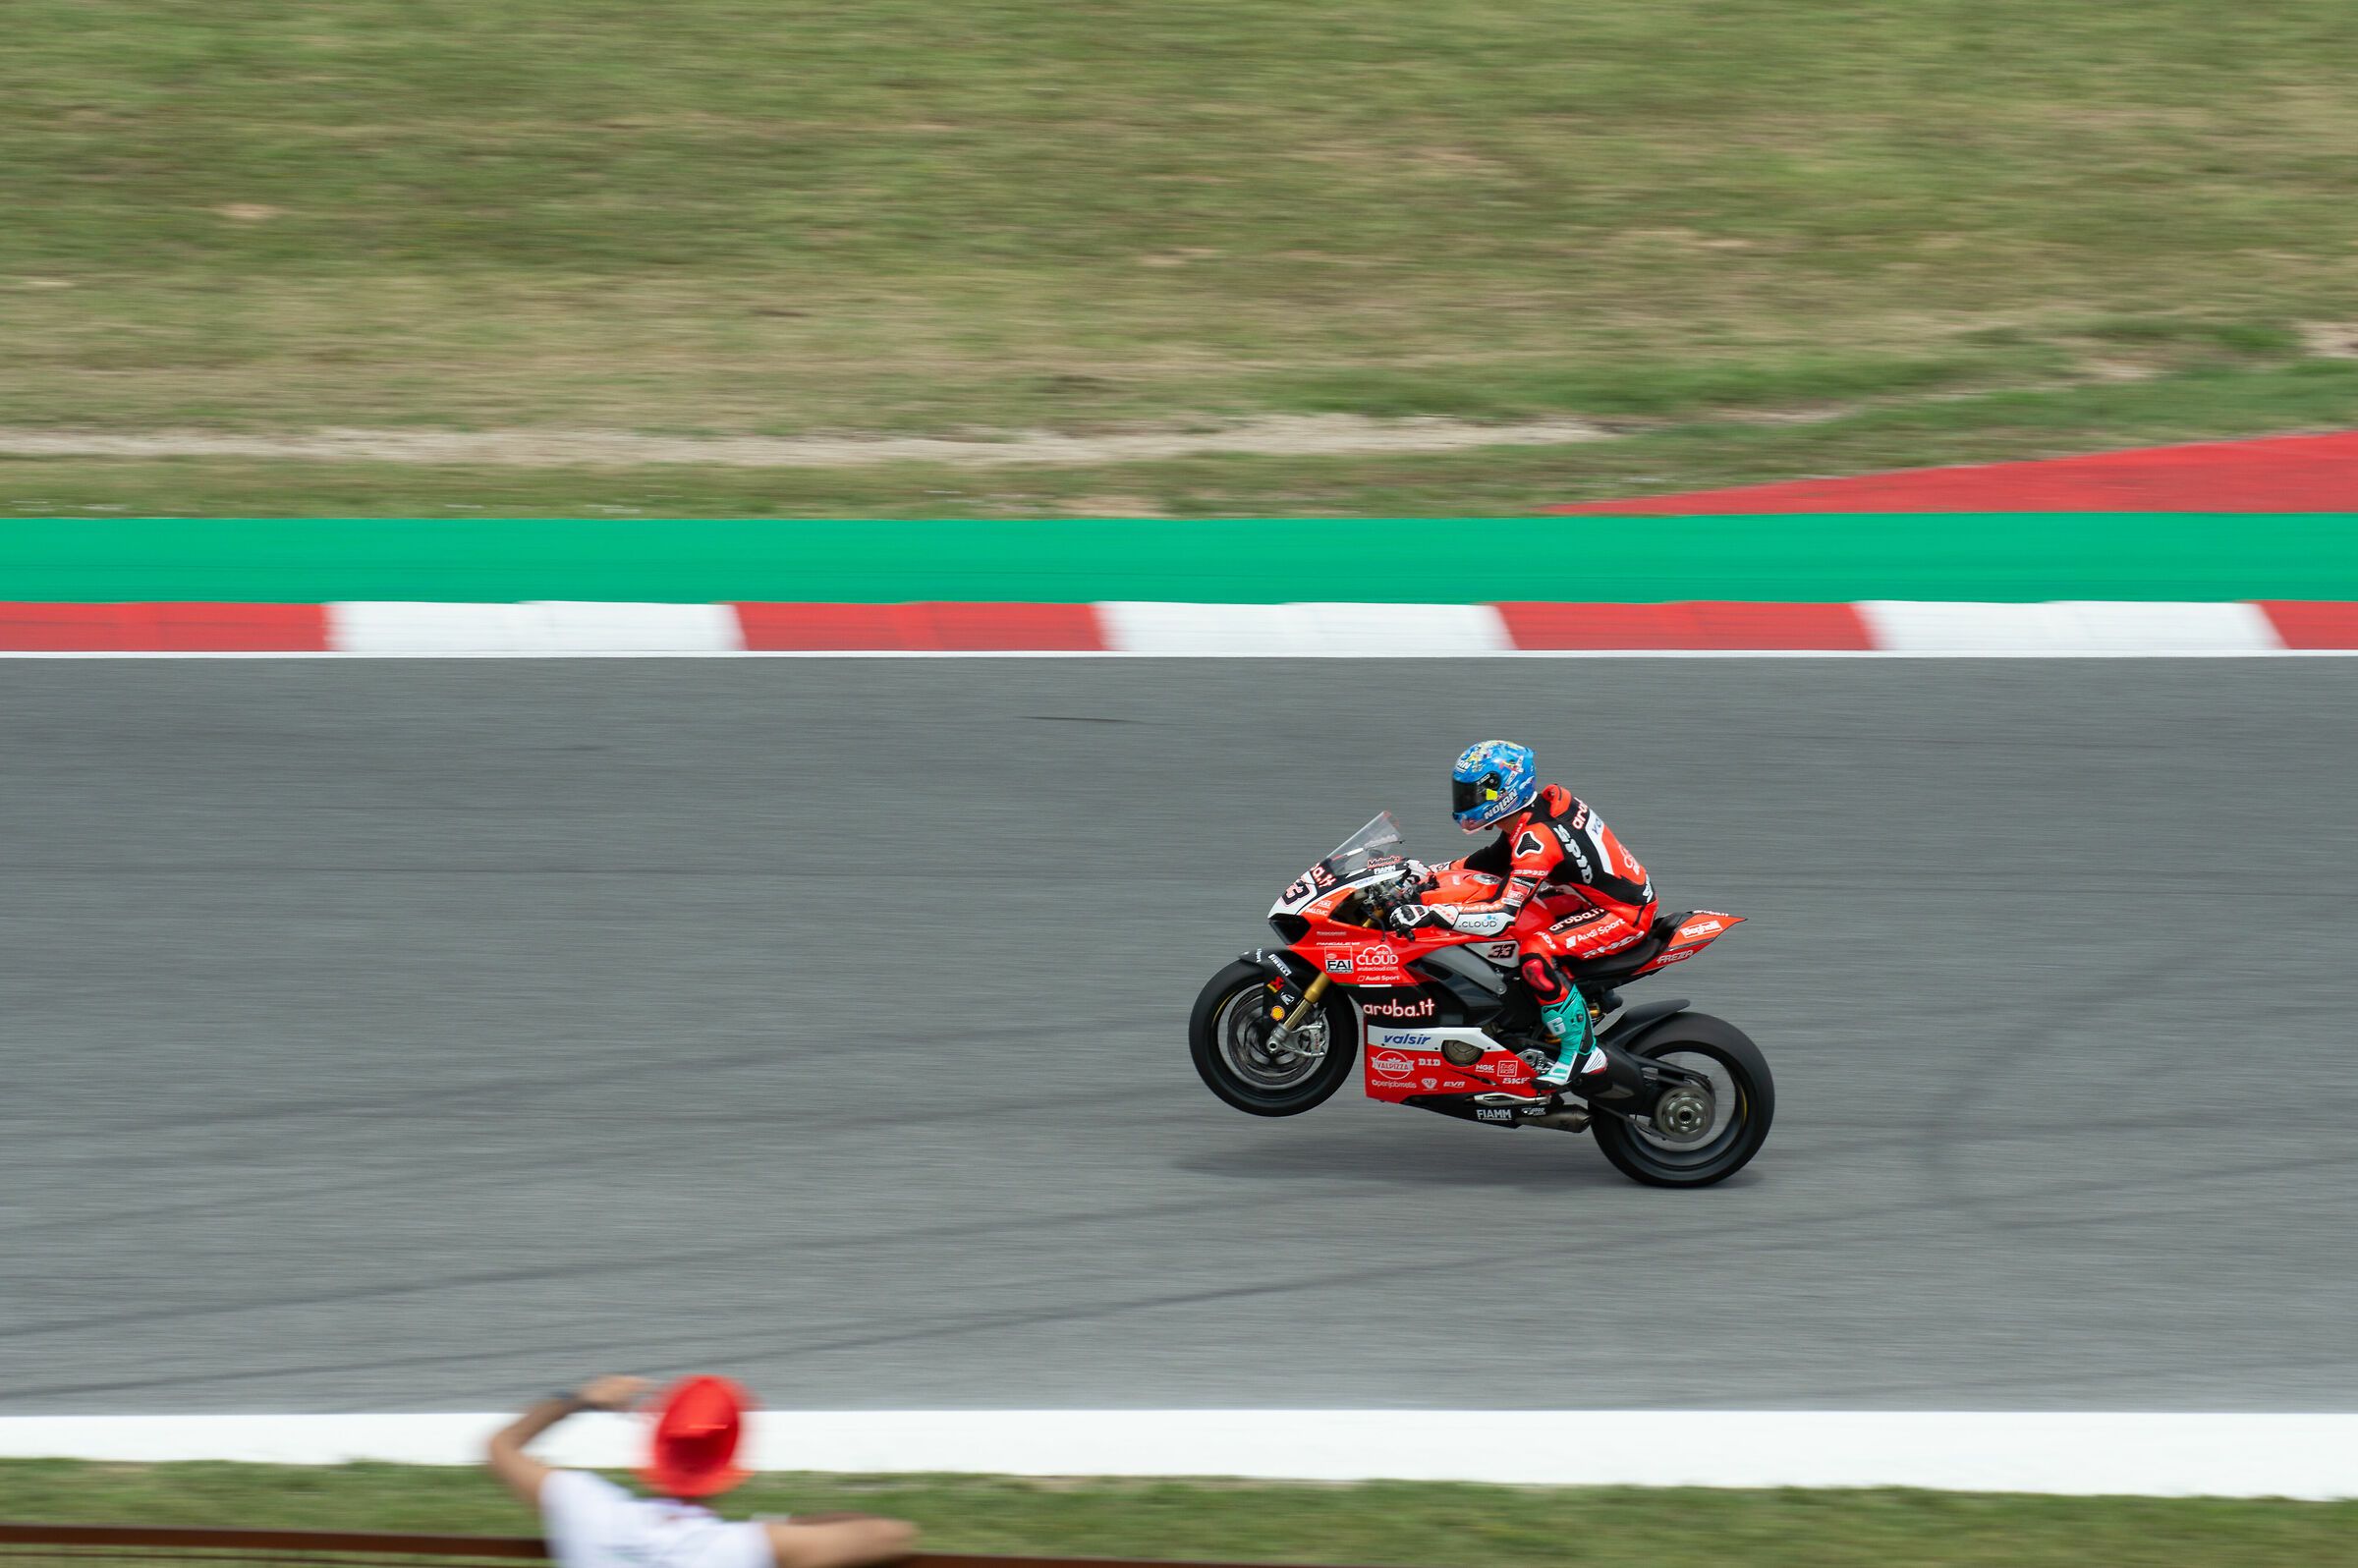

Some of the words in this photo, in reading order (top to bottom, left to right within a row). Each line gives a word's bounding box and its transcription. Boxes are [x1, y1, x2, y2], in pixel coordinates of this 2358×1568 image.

[1484, 788, 1518, 819] NOLAN
[1577, 929, 1599, 942] Audi
[1597, 918, 1626, 935] Sport
[1487, 943, 1517, 959] 33
[1327, 960, 1351, 969] FAI
[1356, 954, 1399, 965] CLOUD
[1363, 998, 1434, 1017] aruba.it
[1383, 1034, 1432, 1045] valsir
[1477, 1108, 1512, 1118] FIAMM
